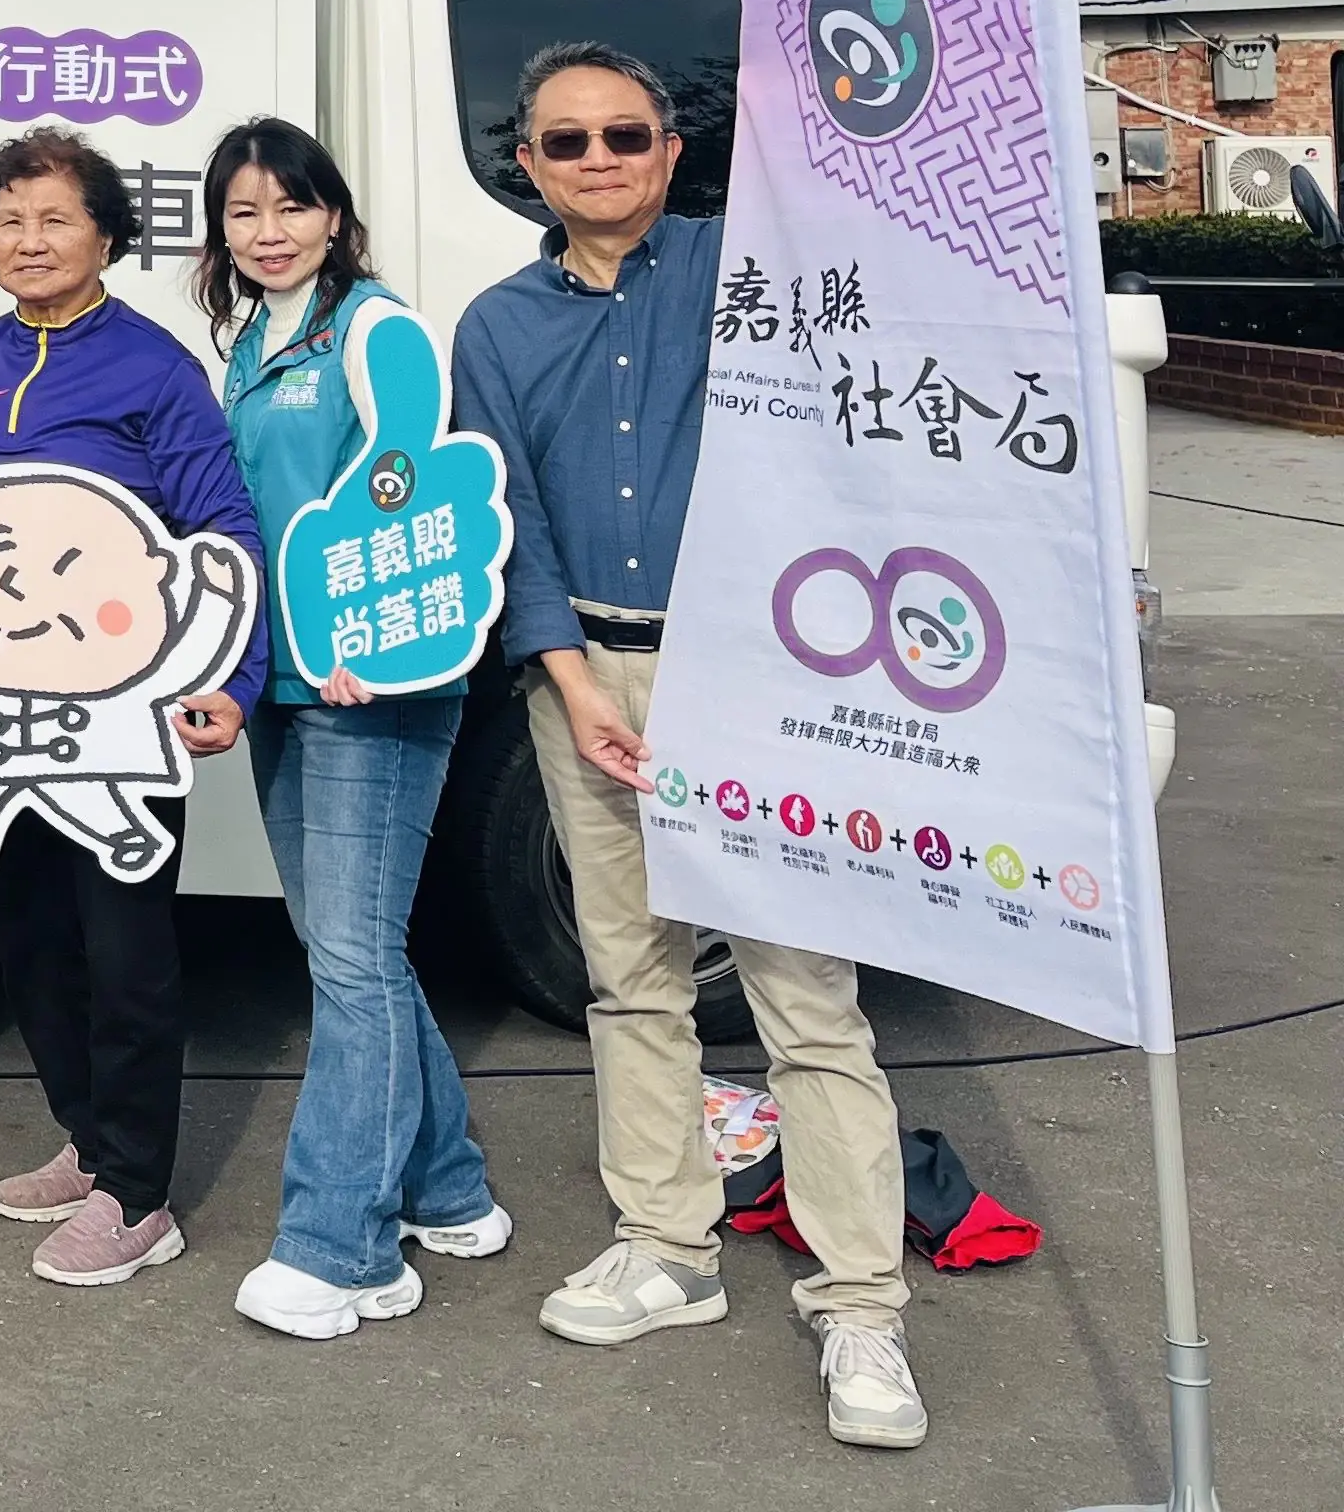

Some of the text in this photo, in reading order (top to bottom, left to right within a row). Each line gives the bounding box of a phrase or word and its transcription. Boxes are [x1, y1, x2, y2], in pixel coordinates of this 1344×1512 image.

[713, 256, 871, 371] 嘉義縣
[706, 369, 732, 380] ocial
[735, 371, 780, 388] Affairs
[768, 398, 825, 428] County
[831, 352, 1078, 475] 社會局
[323, 503, 458, 600] 嘉義縣
[330, 572, 467, 664] 尚蓋讚
[830, 704, 939, 743] 嘉義縣社會局
